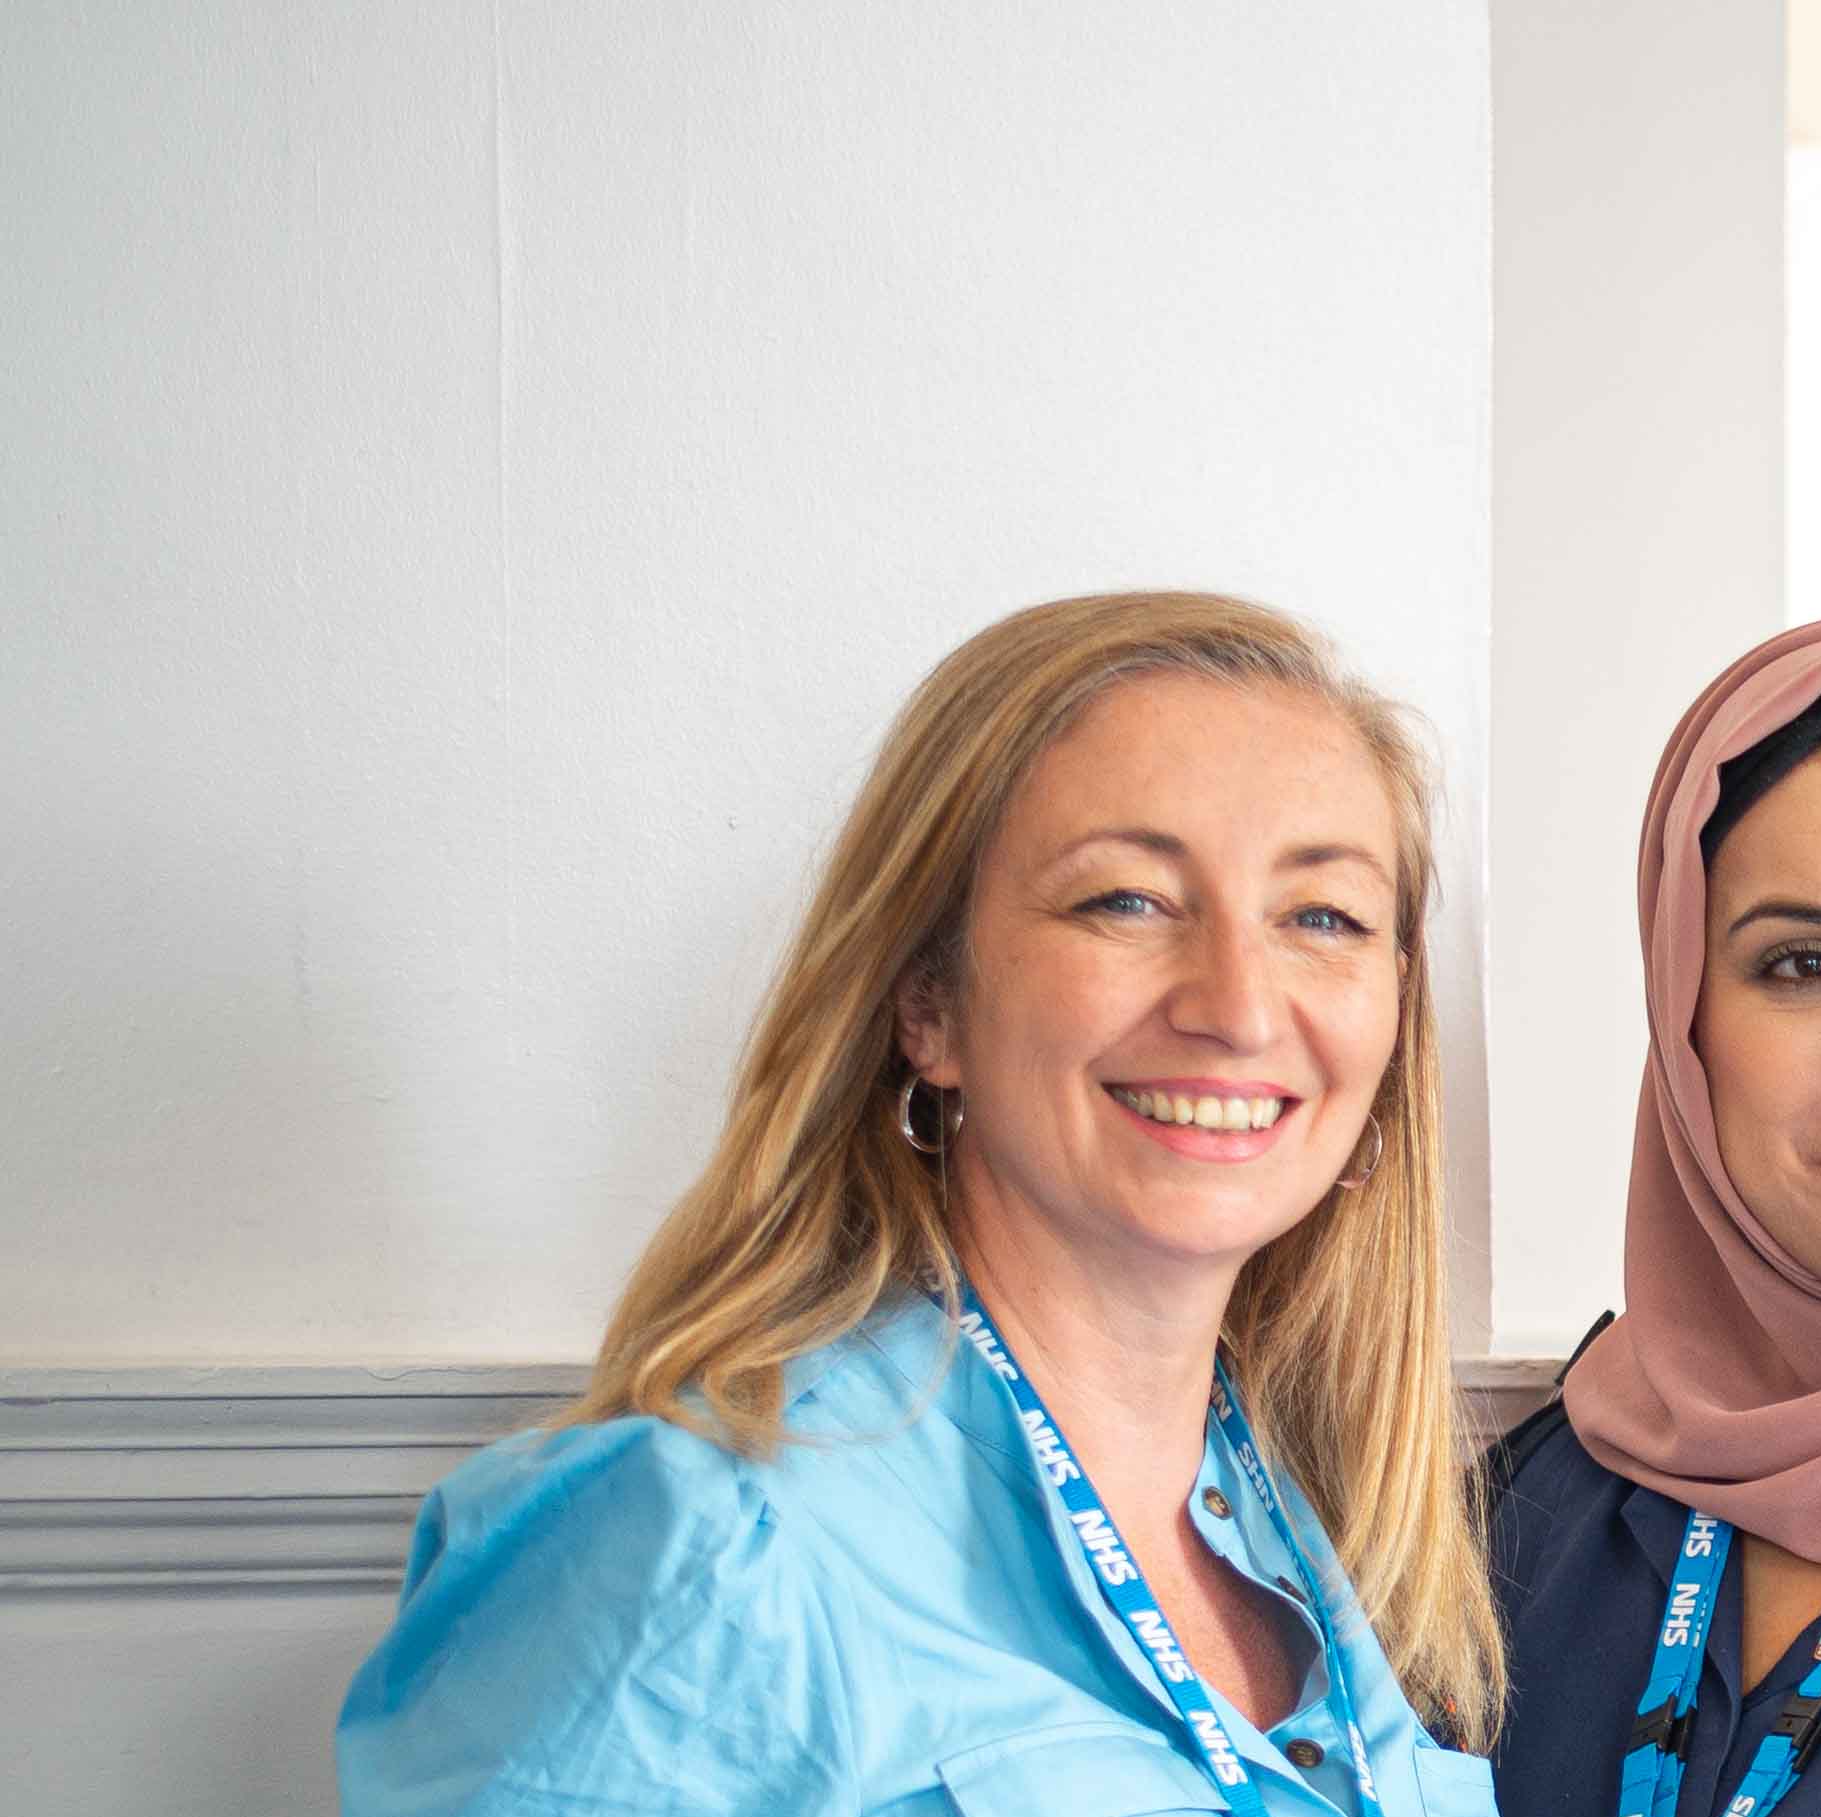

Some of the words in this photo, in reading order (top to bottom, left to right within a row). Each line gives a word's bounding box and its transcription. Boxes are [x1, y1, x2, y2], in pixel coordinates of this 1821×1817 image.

[1022, 1409, 1080, 1487] NHS
[1069, 1508, 1139, 1587] NHS
[1129, 1609, 1196, 1684] NHS
[1663, 1583, 1701, 1648] NHS
[1190, 1711, 1249, 1787] NHS
